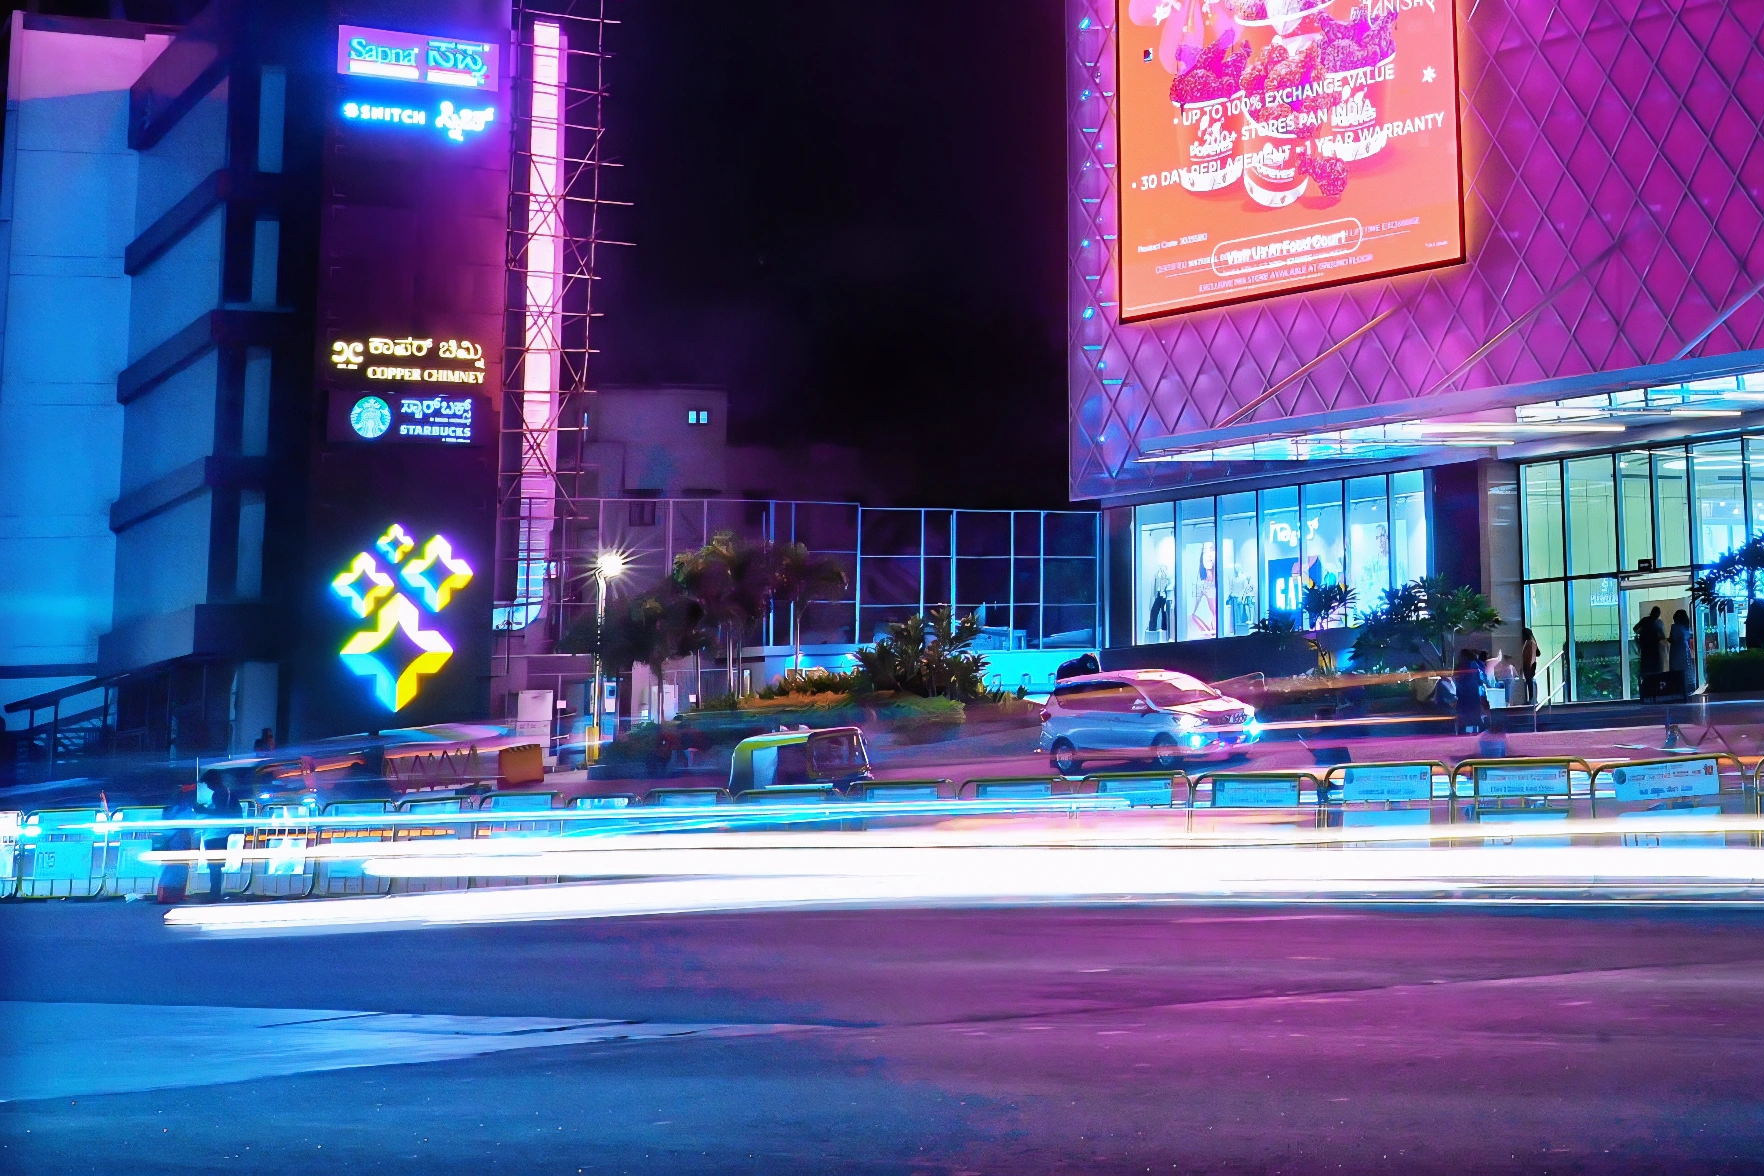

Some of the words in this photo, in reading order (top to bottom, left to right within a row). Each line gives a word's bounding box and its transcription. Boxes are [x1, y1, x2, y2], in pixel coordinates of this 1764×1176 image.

[350, 37, 416, 66] Sapna
[1182, 109, 1200, 125] UP
[1203, 104, 1222, 119] TO
[1226, 94, 1262, 115] 100%
[1265, 80, 1343, 107] EXCHANGE
[1347, 64, 1395, 89] VALUE
[360, 104, 426, 125] SNITCH
[1241, 113, 1295, 141] STORES
[1298, 108, 1328, 127] PAN
[1140, 174, 1157, 190] 30
[1161, 168, 1187, 186] DAY
[1314, 131, 1355, 153] YEAR
[1358, 112, 1445, 145] WARRANTY
[367, 366, 421, 381] COPPER
[423, 369, 486, 384] CHIMNEY
[400, 425, 472, 437] STARBUCKS
